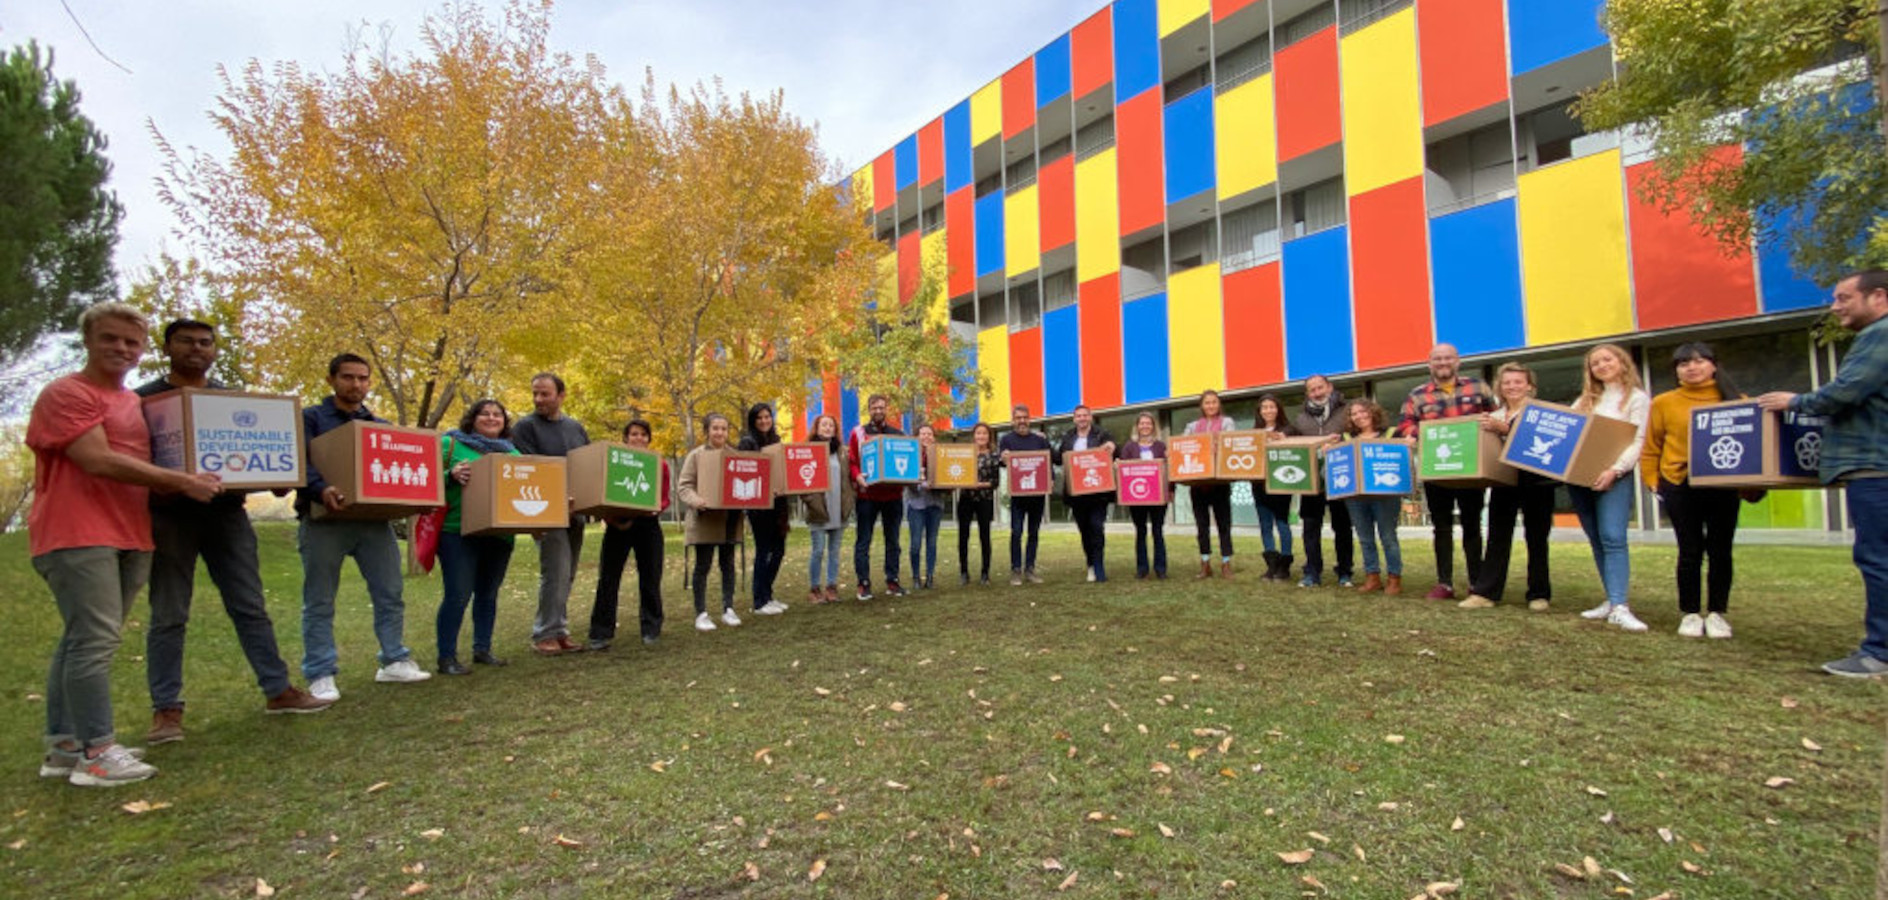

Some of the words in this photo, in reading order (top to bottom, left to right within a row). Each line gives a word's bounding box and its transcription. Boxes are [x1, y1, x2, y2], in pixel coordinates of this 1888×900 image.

[1526, 409, 1540, 424] 16
[1696, 413, 1709, 430] 17
[197, 428, 292, 442] SUSTAINABLE
[369, 432, 377, 449] 1
[198, 441, 293, 452] DEVELOPMENT
[611, 450, 619, 464] 3
[787, 448, 795, 460] 5
[200, 453, 294, 472] GOALS
[728, 459, 735, 472] 4
[502, 463, 512, 479] 2
